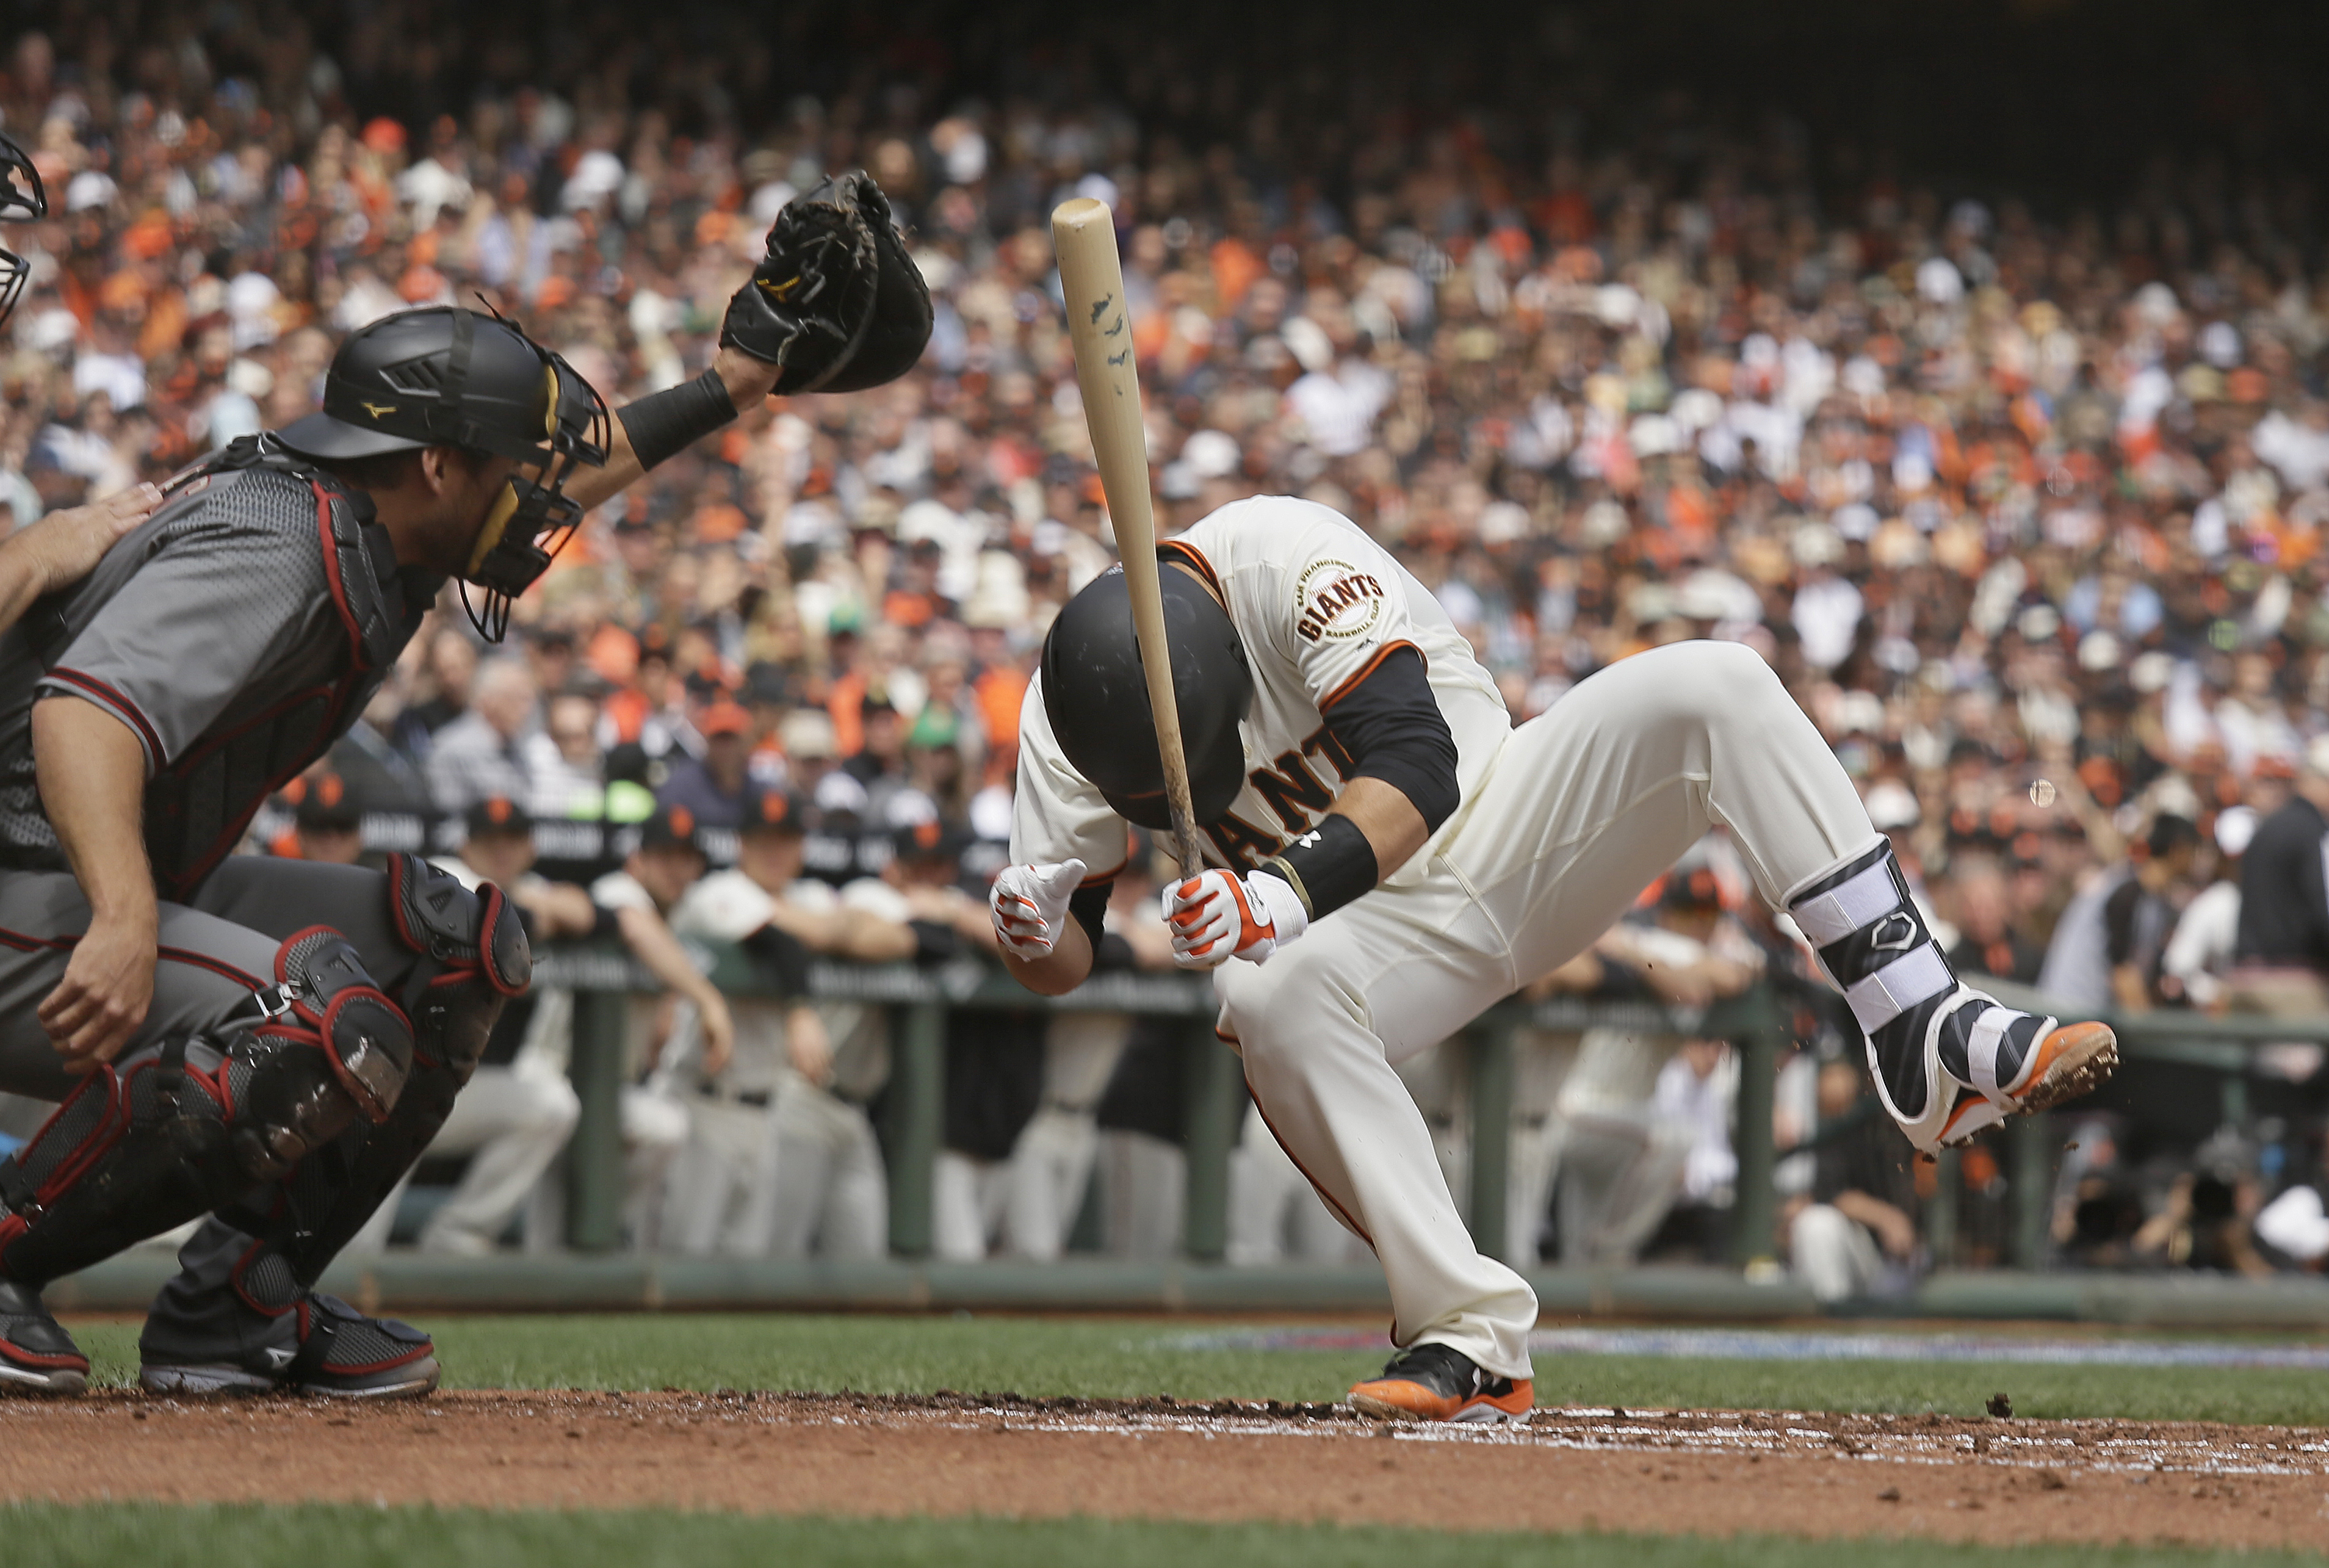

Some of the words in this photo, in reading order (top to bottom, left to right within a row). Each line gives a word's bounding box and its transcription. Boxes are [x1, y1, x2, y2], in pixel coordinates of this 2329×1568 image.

[1296, 574, 1385, 643] GIANTS
[1325, 621, 1374, 637] BASEBALL
[1199, 724, 1359, 882] ANT
